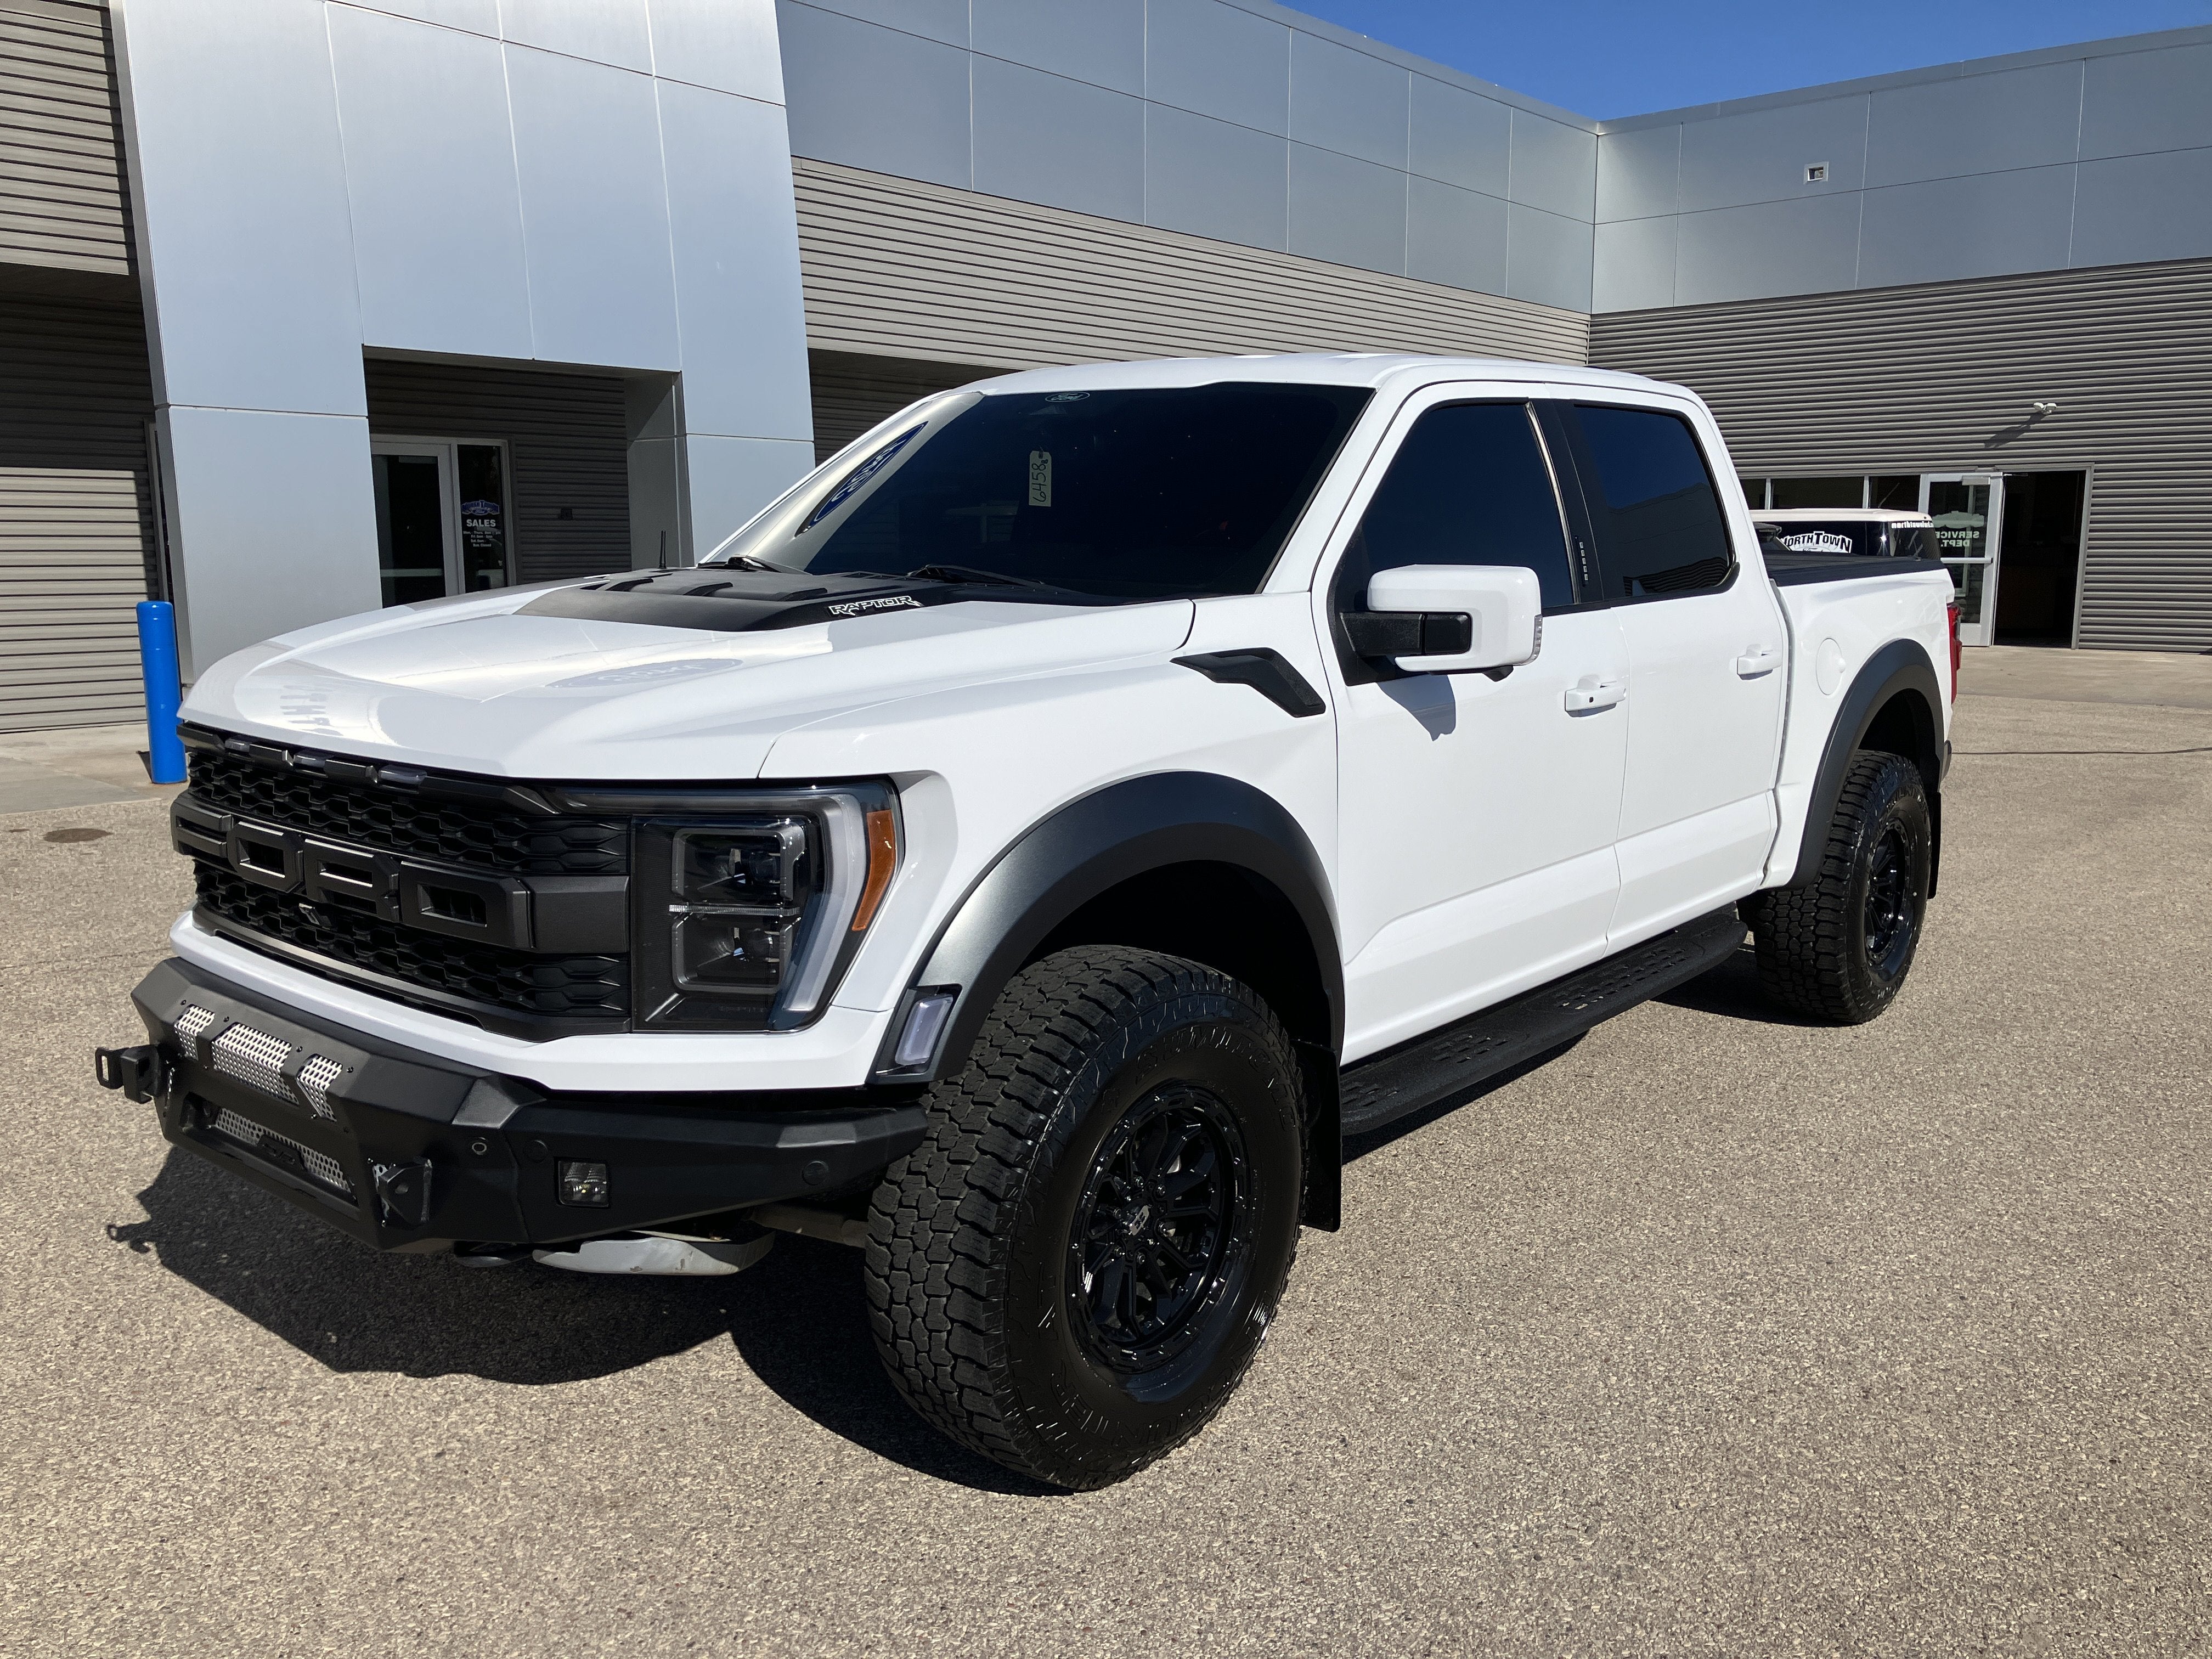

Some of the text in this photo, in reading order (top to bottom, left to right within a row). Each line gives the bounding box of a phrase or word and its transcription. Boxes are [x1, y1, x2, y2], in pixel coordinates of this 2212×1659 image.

[466, 519, 496, 527] SALES
[828, 595, 921, 616] RAPTOR
[171, 794, 535, 949] FORD
